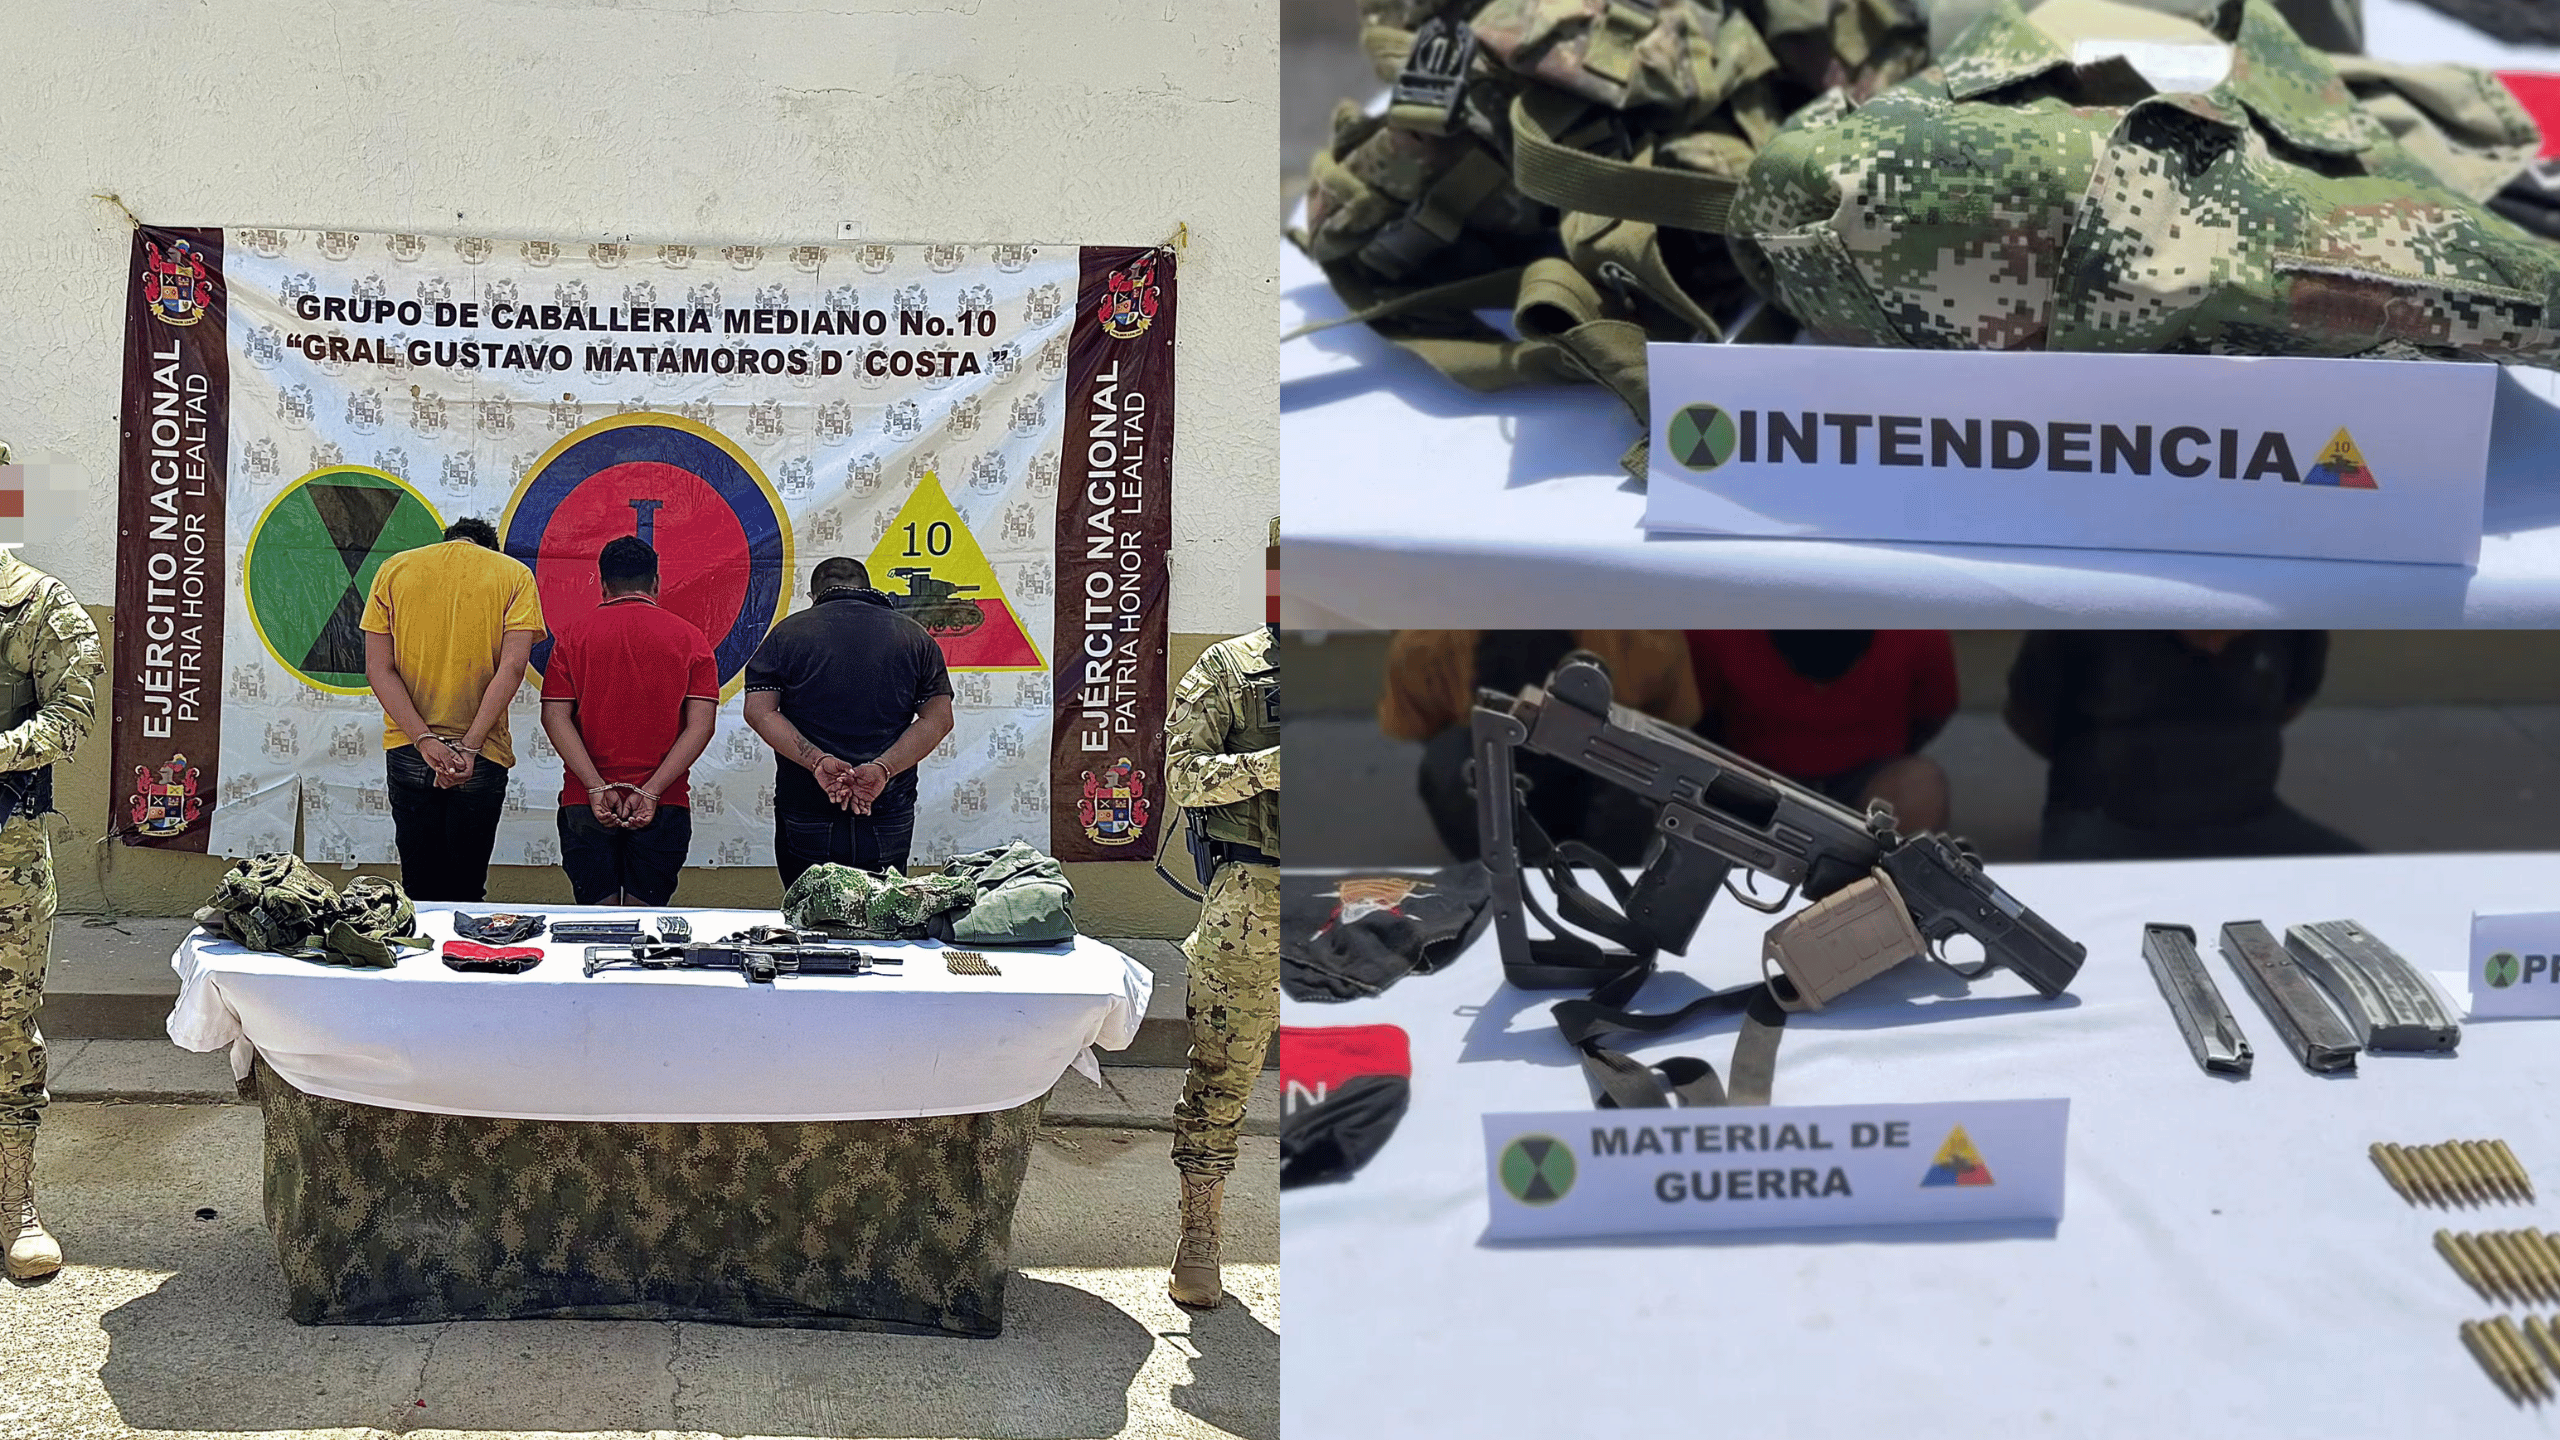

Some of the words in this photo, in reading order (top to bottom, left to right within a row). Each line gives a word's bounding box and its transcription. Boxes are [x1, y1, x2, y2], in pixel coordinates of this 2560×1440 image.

[297, 294, 423, 327] GRUPO
[435, 303, 479, 328] DE
[491, 303, 713, 333] CABALLERIA
[724, 308, 887, 335] MEDIANO
[899, 310, 997, 337] No.10
[407, 339, 573, 371] GUSTAVO
[585, 346, 809, 374] MATAMOROS
[865, 350, 981, 377] COSTA
[149, 339, 181, 541] NACIONAL
[184, 373, 208, 497] LEALTAD
[1086, 360, 1119, 560] NACIONAL
[1121, 392, 1145, 514] LEALTAD
[1739, 410, 2301, 484] INTENDENCIA
[181, 513, 206, 618] HONOR
[902, 521, 952, 557] 10
[1119, 530, 1142, 632] HONOR
[137, 552, 178, 738] EJÉRCITO
[178, 625, 203, 721] PATRIA
[1077, 571, 1115, 752] EJÉRCITO
[1115, 638, 1139, 734] PATRIA
[1590, 1122, 1834, 1157] MATERIAL
[1850, 1121, 1911, 1149] DE
[1654, 1166, 1853, 1204] GUERRA
